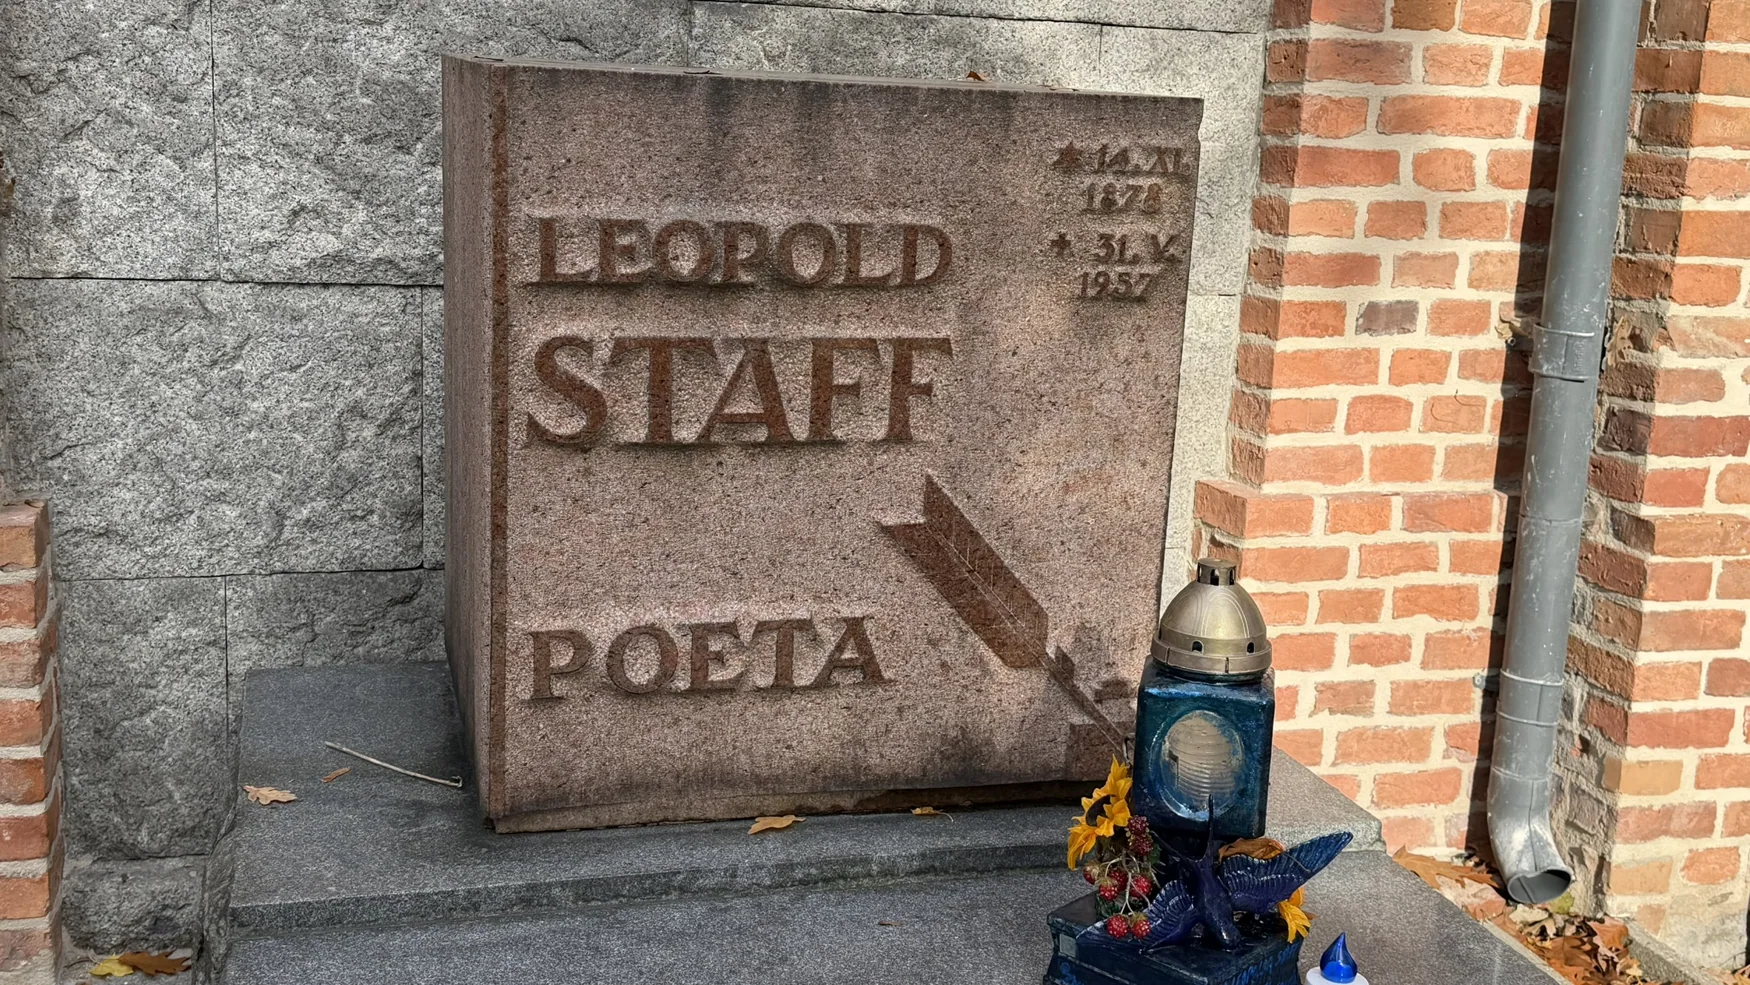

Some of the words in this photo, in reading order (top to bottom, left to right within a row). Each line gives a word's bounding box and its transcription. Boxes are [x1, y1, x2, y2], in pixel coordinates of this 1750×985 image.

[1084, 182, 1163, 214] 1878
[525, 215, 953, 287] LEOPOLD
[1079, 270, 1152, 300] 1957
[527, 335, 954, 446] STAFF
[528, 614, 897, 702] POETA
